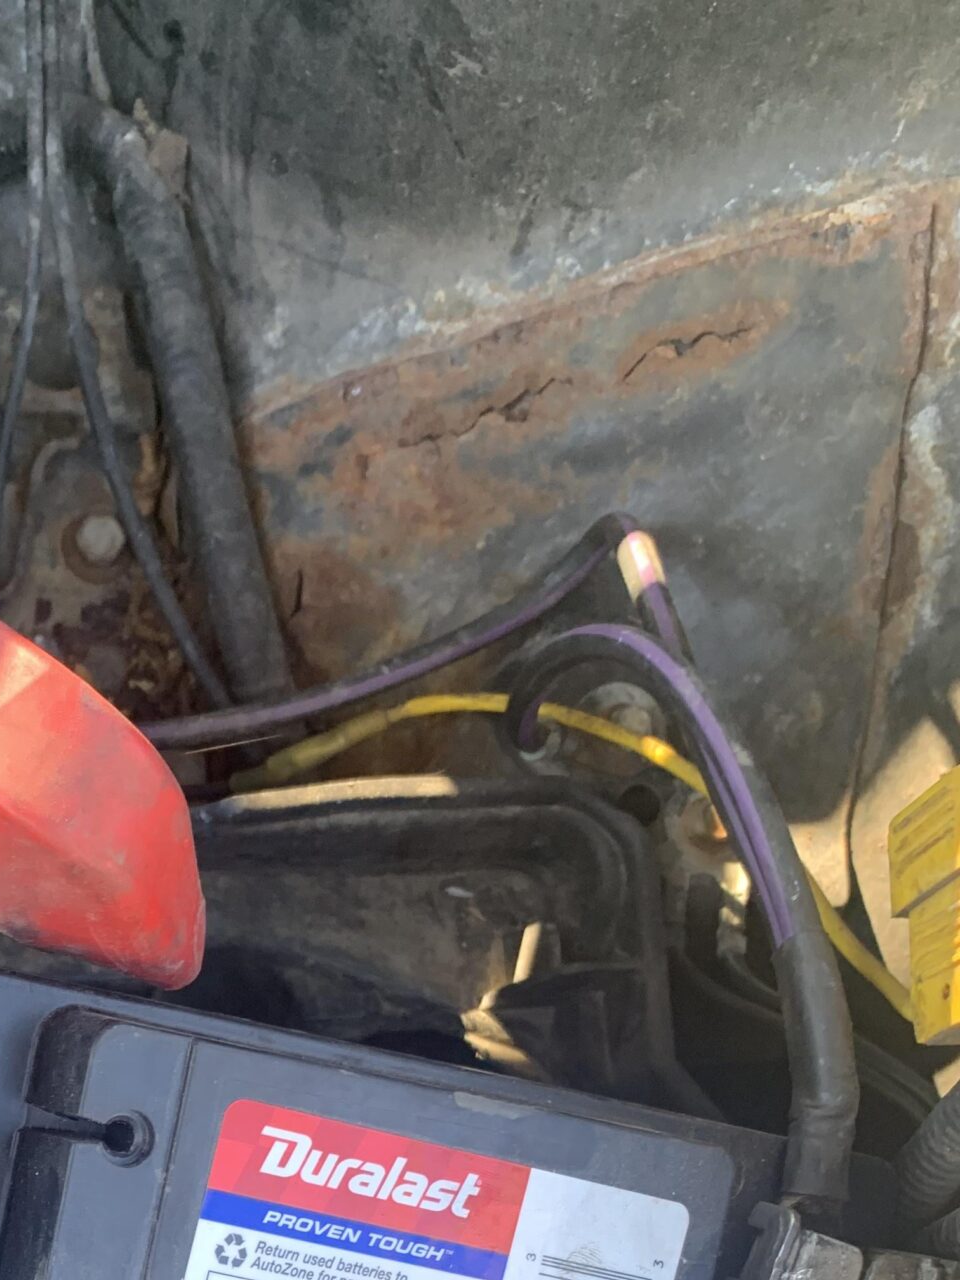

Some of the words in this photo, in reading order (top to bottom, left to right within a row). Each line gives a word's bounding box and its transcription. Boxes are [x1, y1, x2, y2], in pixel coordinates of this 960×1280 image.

[260, 1125, 481, 1218] Duralast
[263, 1210, 361, 1243] PROVEN
[251, 1257, 314, 1280] AutoZone
[255, 1241, 299, 1263] Return
[302, 1252, 335, 1270] used
[526, 1253, 536, 1261] 3
[653, 1260, 664, 1268] 3
